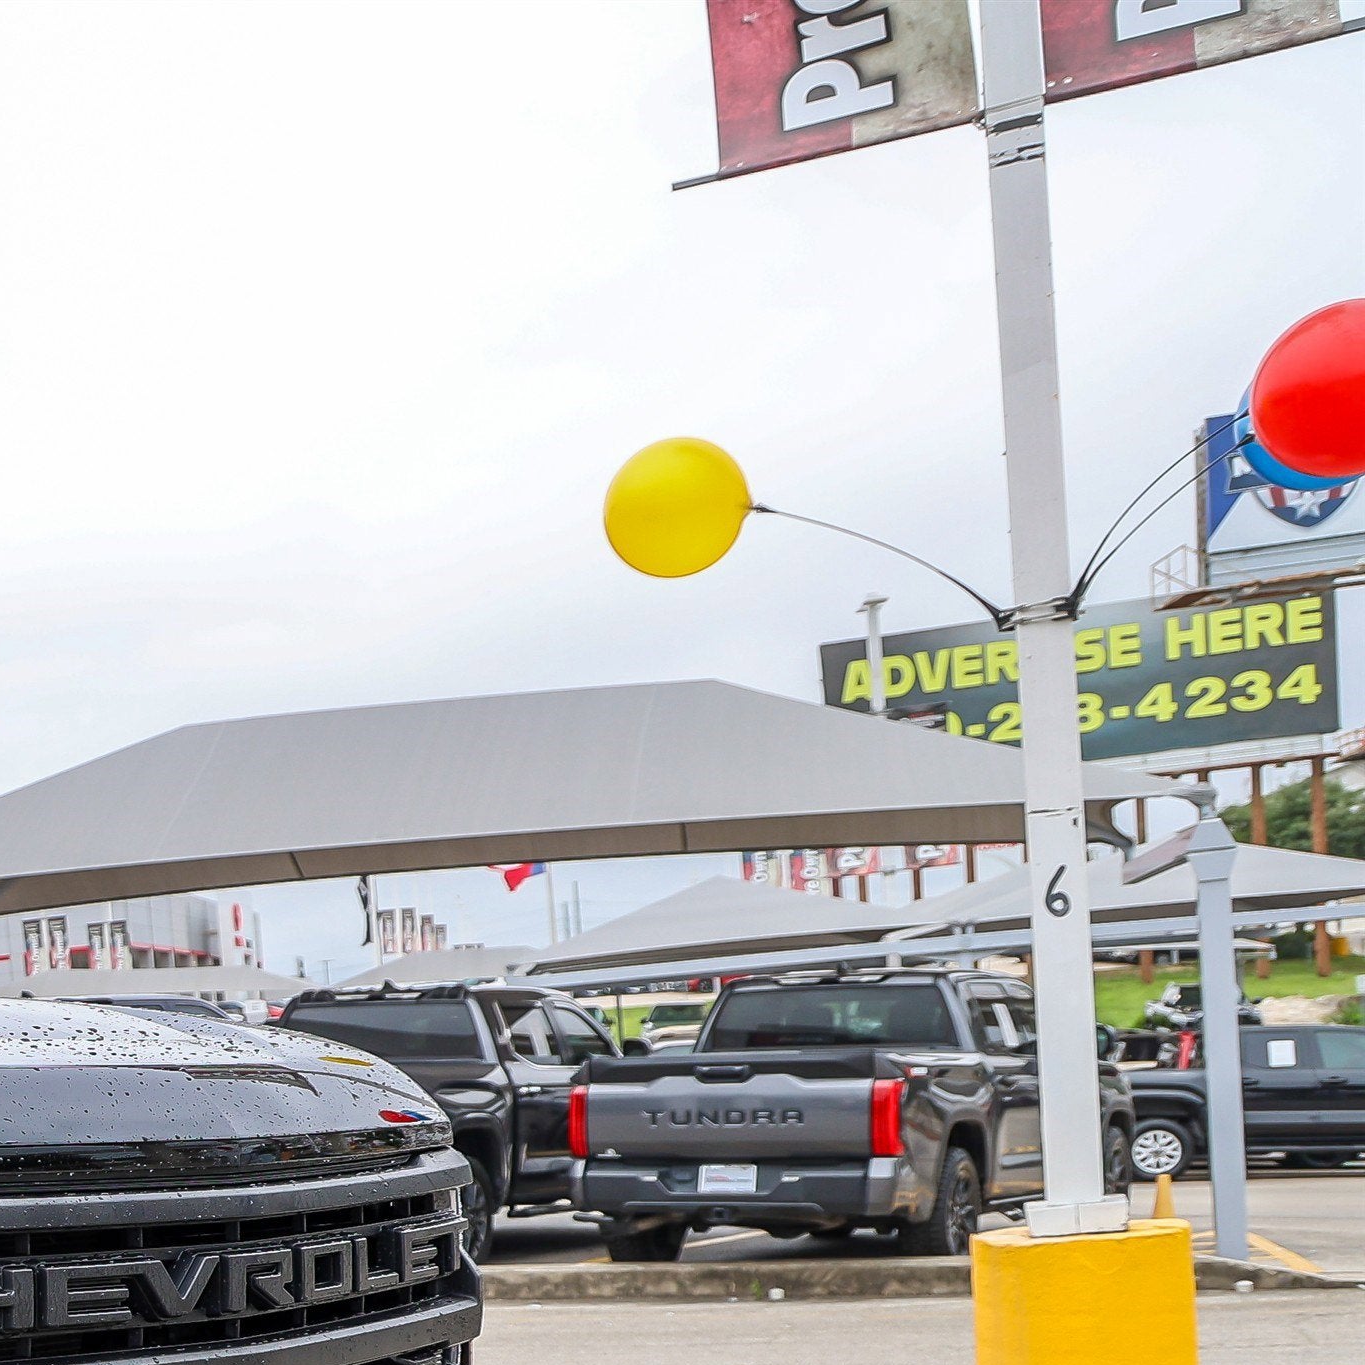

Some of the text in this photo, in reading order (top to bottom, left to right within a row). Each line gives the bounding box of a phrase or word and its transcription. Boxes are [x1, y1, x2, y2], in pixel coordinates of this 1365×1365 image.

[782, 0, 896, 132] Pr
[841, 596, 1325, 704] ADVERSE HERE
[946, 664, 1323, 742] -28-4234
[1045, 864, 1070, 917] 6
[640, 1108, 805, 1129] TUNDRA
